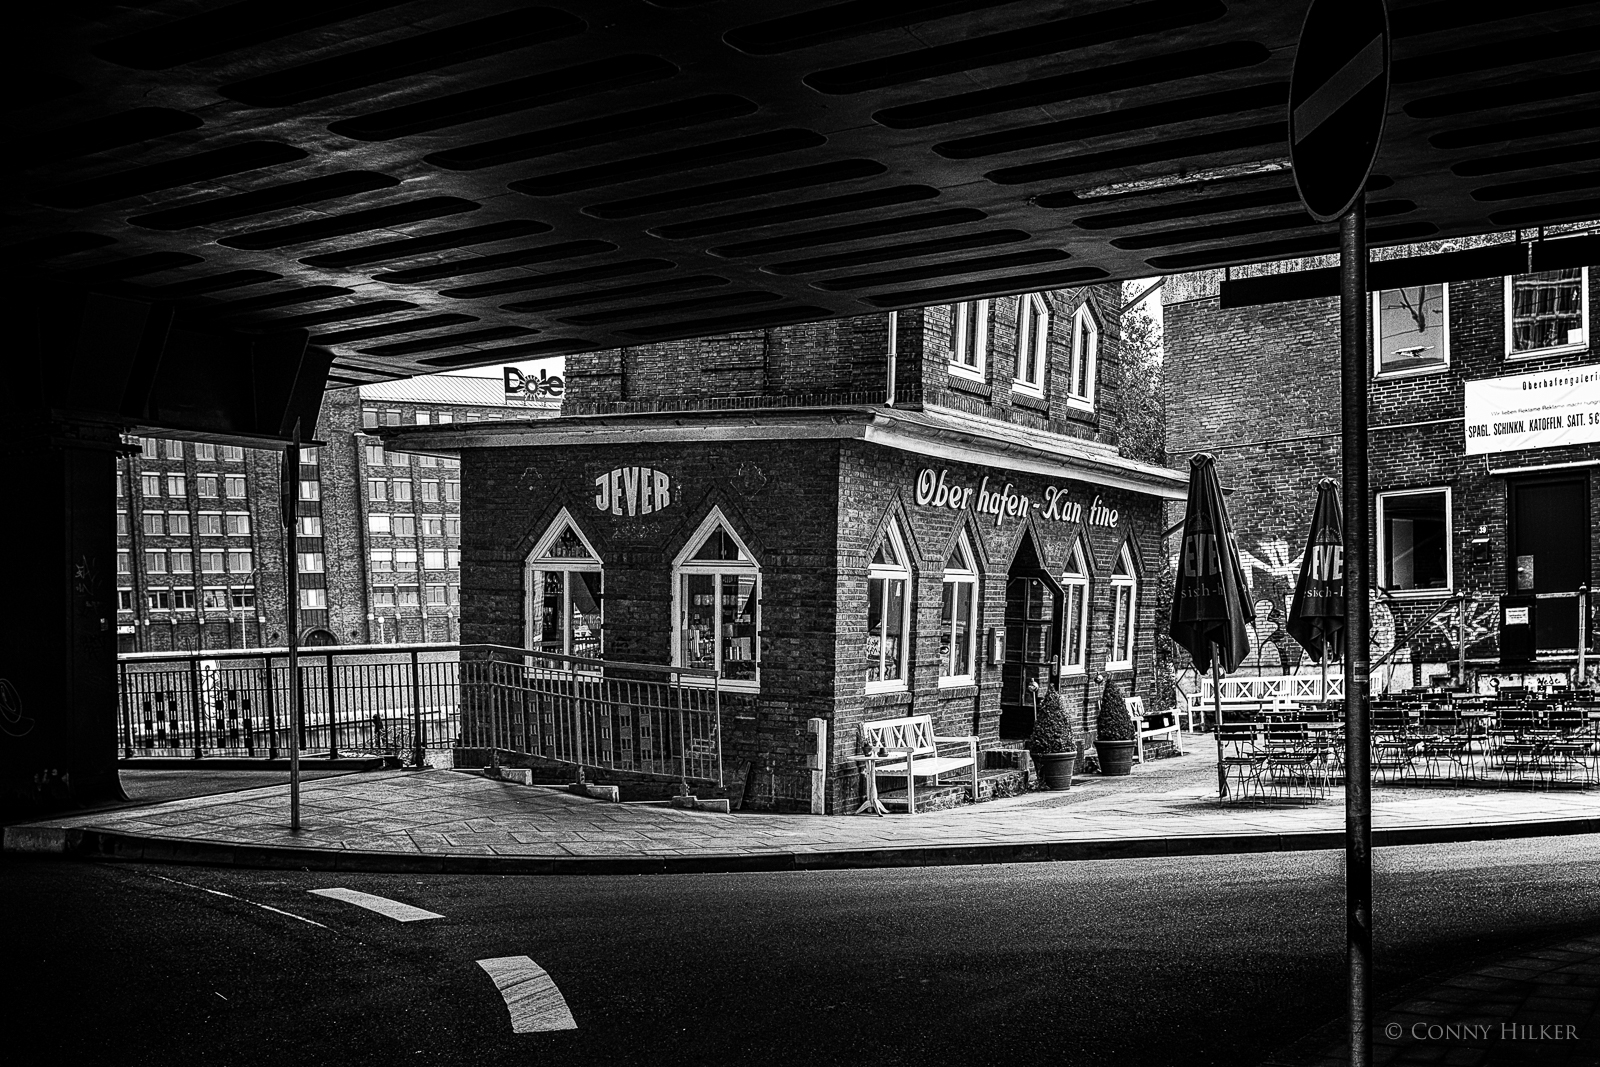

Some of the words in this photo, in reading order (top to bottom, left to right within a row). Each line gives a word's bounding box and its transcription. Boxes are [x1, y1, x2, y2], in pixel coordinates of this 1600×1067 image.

[503, 366, 564, 398] Dole
[1522, 371, 1600, 391] Oberhafengaleri
[1468, 424, 1491, 439] SPAGL.
[1493, 420, 1526, 436] SCHINKN.
[1529, 415, 1564, 432] KATOFFLN.
[1567, 413, 1586, 428] SATT.
[595, 466, 670, 517] JEVER
[916, 468, 972, 510] Ober
[1184, 533, 1219, 577] EVE
[1311, 545, 1344, 581] EVE
